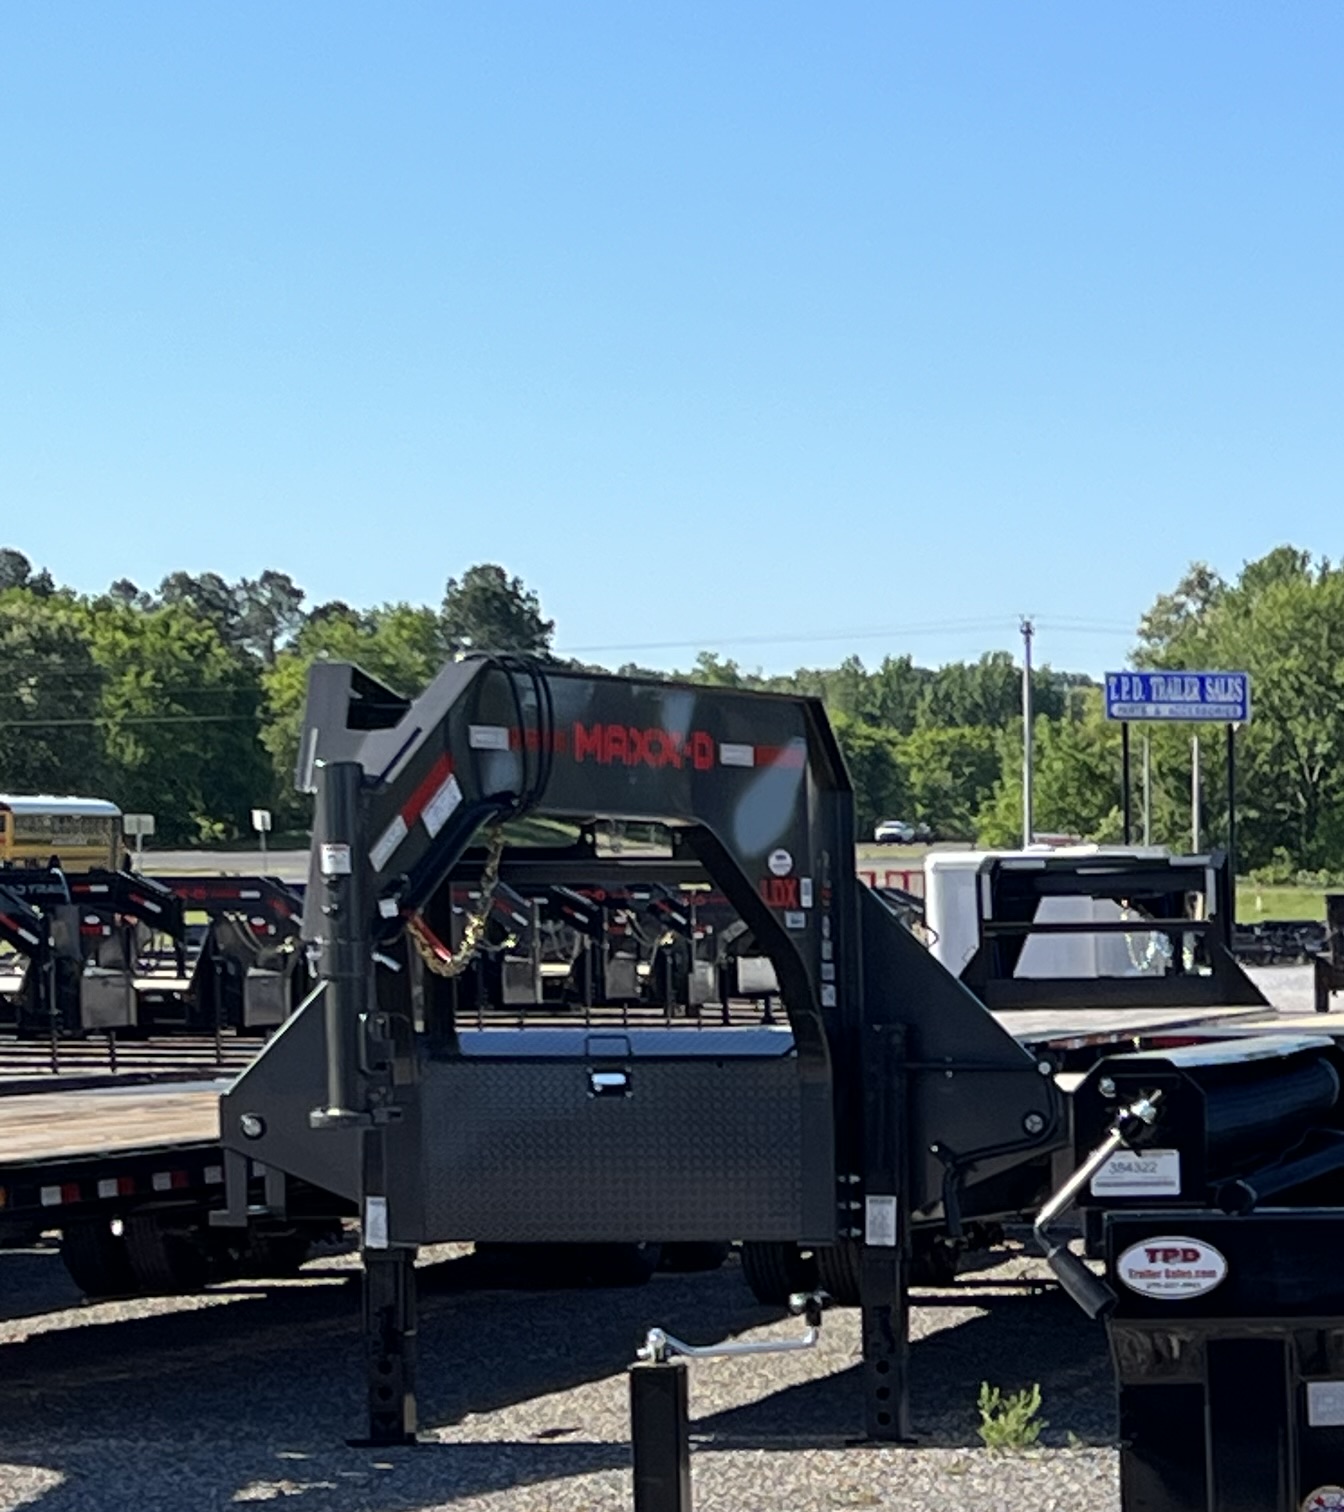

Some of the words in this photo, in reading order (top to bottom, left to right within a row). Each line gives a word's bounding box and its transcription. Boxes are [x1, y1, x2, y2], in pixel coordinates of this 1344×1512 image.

[1150, 676, 1201, 702] TRAILER
[1204, 676, 1244, 703] SALES
[573, 721, 715, 770] MAXX-D
[1144, 1247, 1201, 1264] TPD
